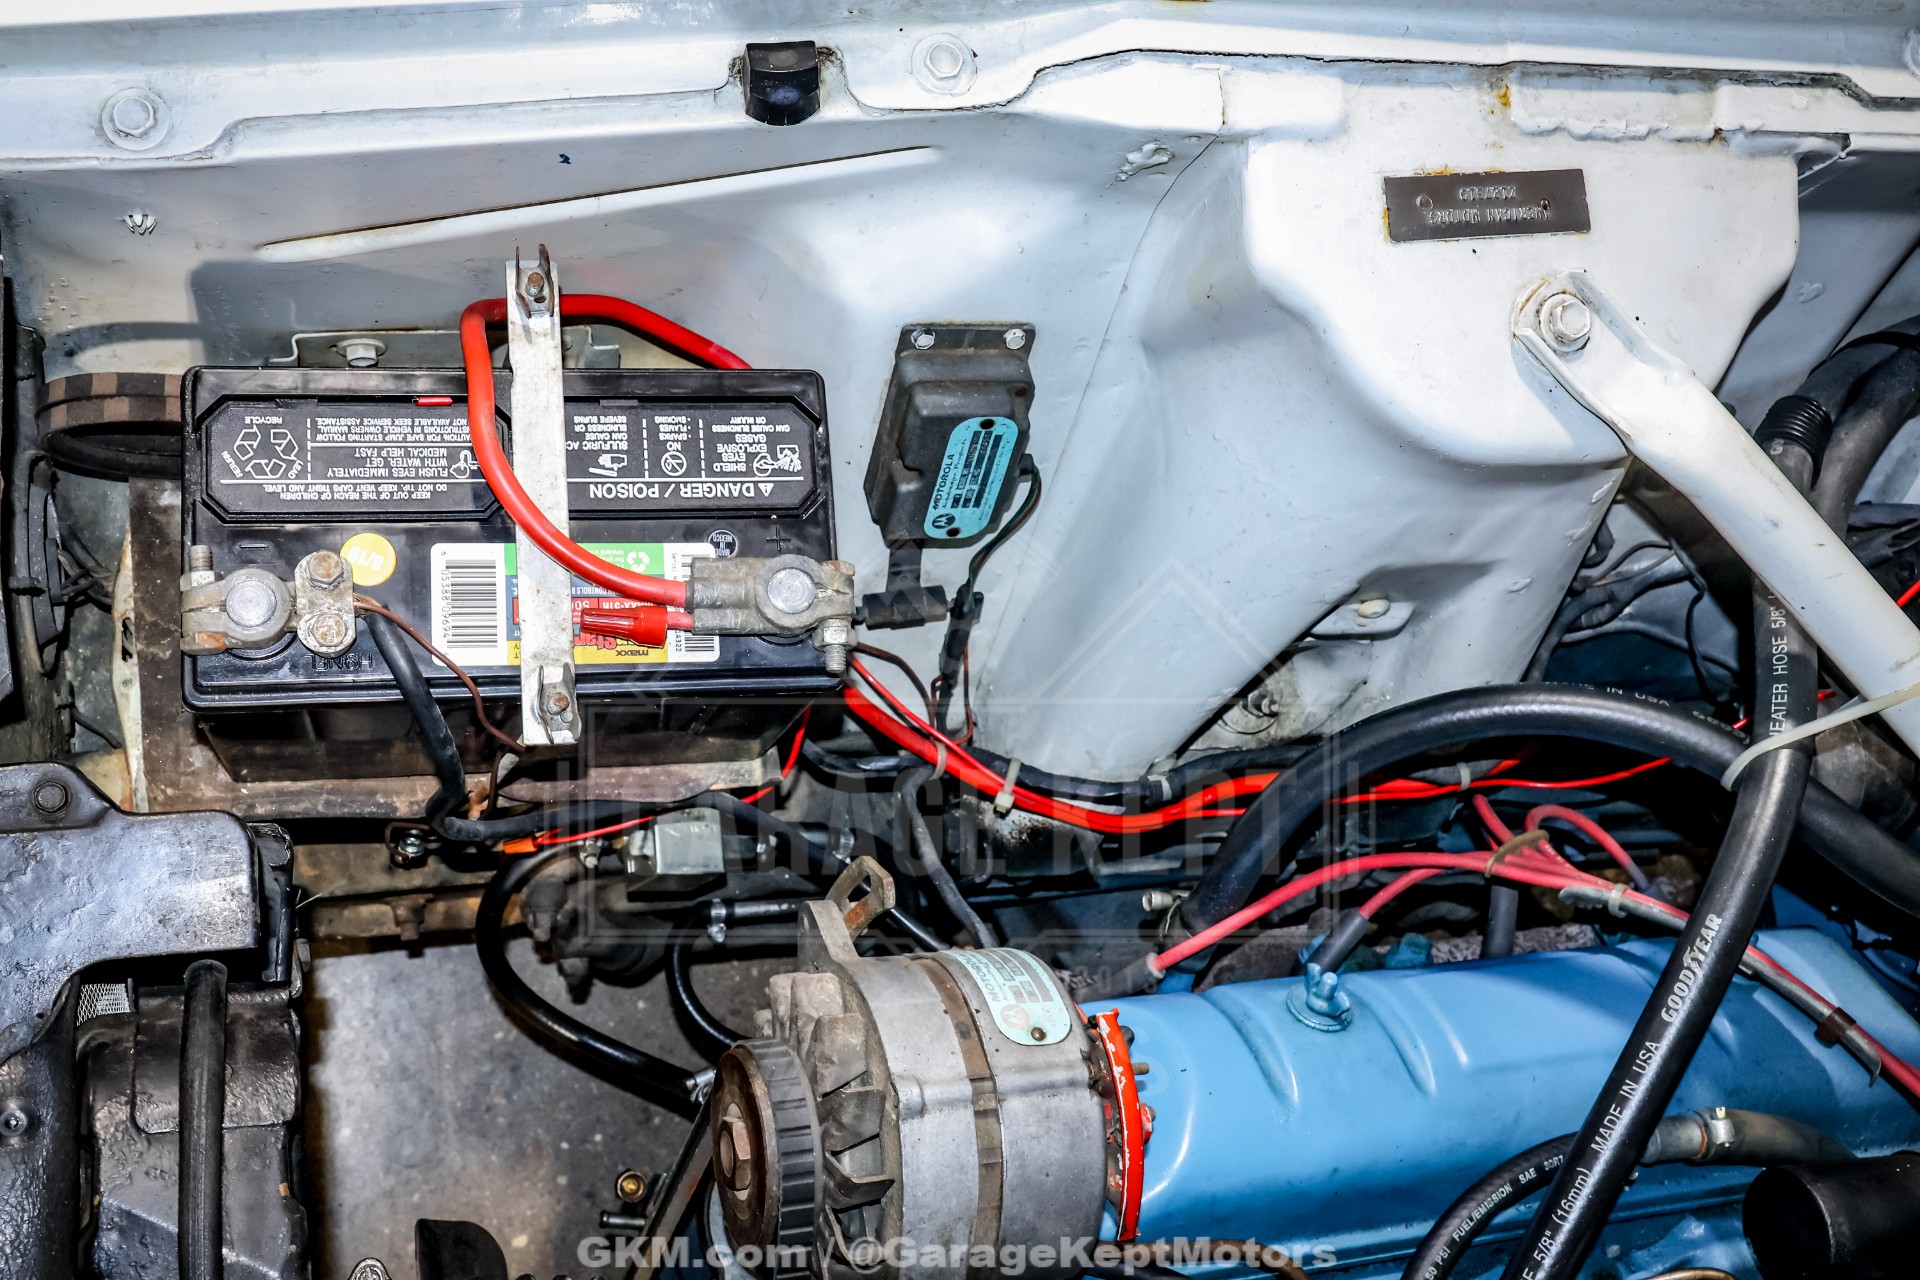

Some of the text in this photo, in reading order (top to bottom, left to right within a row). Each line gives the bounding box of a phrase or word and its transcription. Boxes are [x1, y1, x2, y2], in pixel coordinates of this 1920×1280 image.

[1429, 205, 1549, 224] AMERICAN MOTORS
[573, 415, 627, 423] SEVERE BURNS
[659, 424, 687, 432] FLAMES
[735, 434, 766, 443] GASES
[565, 441, 628, 450] SULFURIC AC
[667, 441, 681, 450] NO
[717, 444, 767, 452] EXPLOSIVE
[355, 448, 447, 457] MEDICAL HELP FAST
[722, 453, 746, 461] EYES
[221, 451, 243, 478] RETURN
[365, 458, 448, 467] WITH WATER. GET
[288, 460, 304, 479] LEAD
[713, 463, 746, 472] SHIELD
[327, 468, 448, 477] FLUSH EYES IMMEDIATELY
[932, 453, 955, 511] MOTOROLA
[263, 484, 286, 492] LEVEL
[289, 484, 305, 492] AND
[308, 484, 330, 492] TIGHT
[333, 484, 353, 492] CAPS
[356, 484, 375, 492] VENT
[590, 483, 659, 498] POISON
[680, 483, 754, 497] DANGER
[280, 492, 318, 500] CHILDREN
[320, 492, 332, 500] OF
[334, 492, 359, 500] REACH
[362, 492, 377, 500] THE
[380, 492, 390, 500] OF
[412, 492, 430, 500] KEEP
[713, 534, 732, 542] MEXICO
[348, 546, 384, 571] 8/19
[1772, 635, 1788, 675] HOSE
[1606, 687, 1623, 695] IN
[1635, 692, 1670, 707] USA
[959, 953, 1002, 1003] MOTOROLA
[1551, 1167, 1591, 1225] (16mm)
[1591, 1103, 1624, 1152] MADE
[1619, 1079, 1639, 1100] IN
[1633, 1040, 1661, 1074] USA
[1661, 914, 1723, 1023] GOODYEAR
[1436, 1245, 1451, 1265] PSI
[1452, 1183, 1513, 1242] FUEL/EMISSION
[1518, 1167, 1537, 1184] SAE
